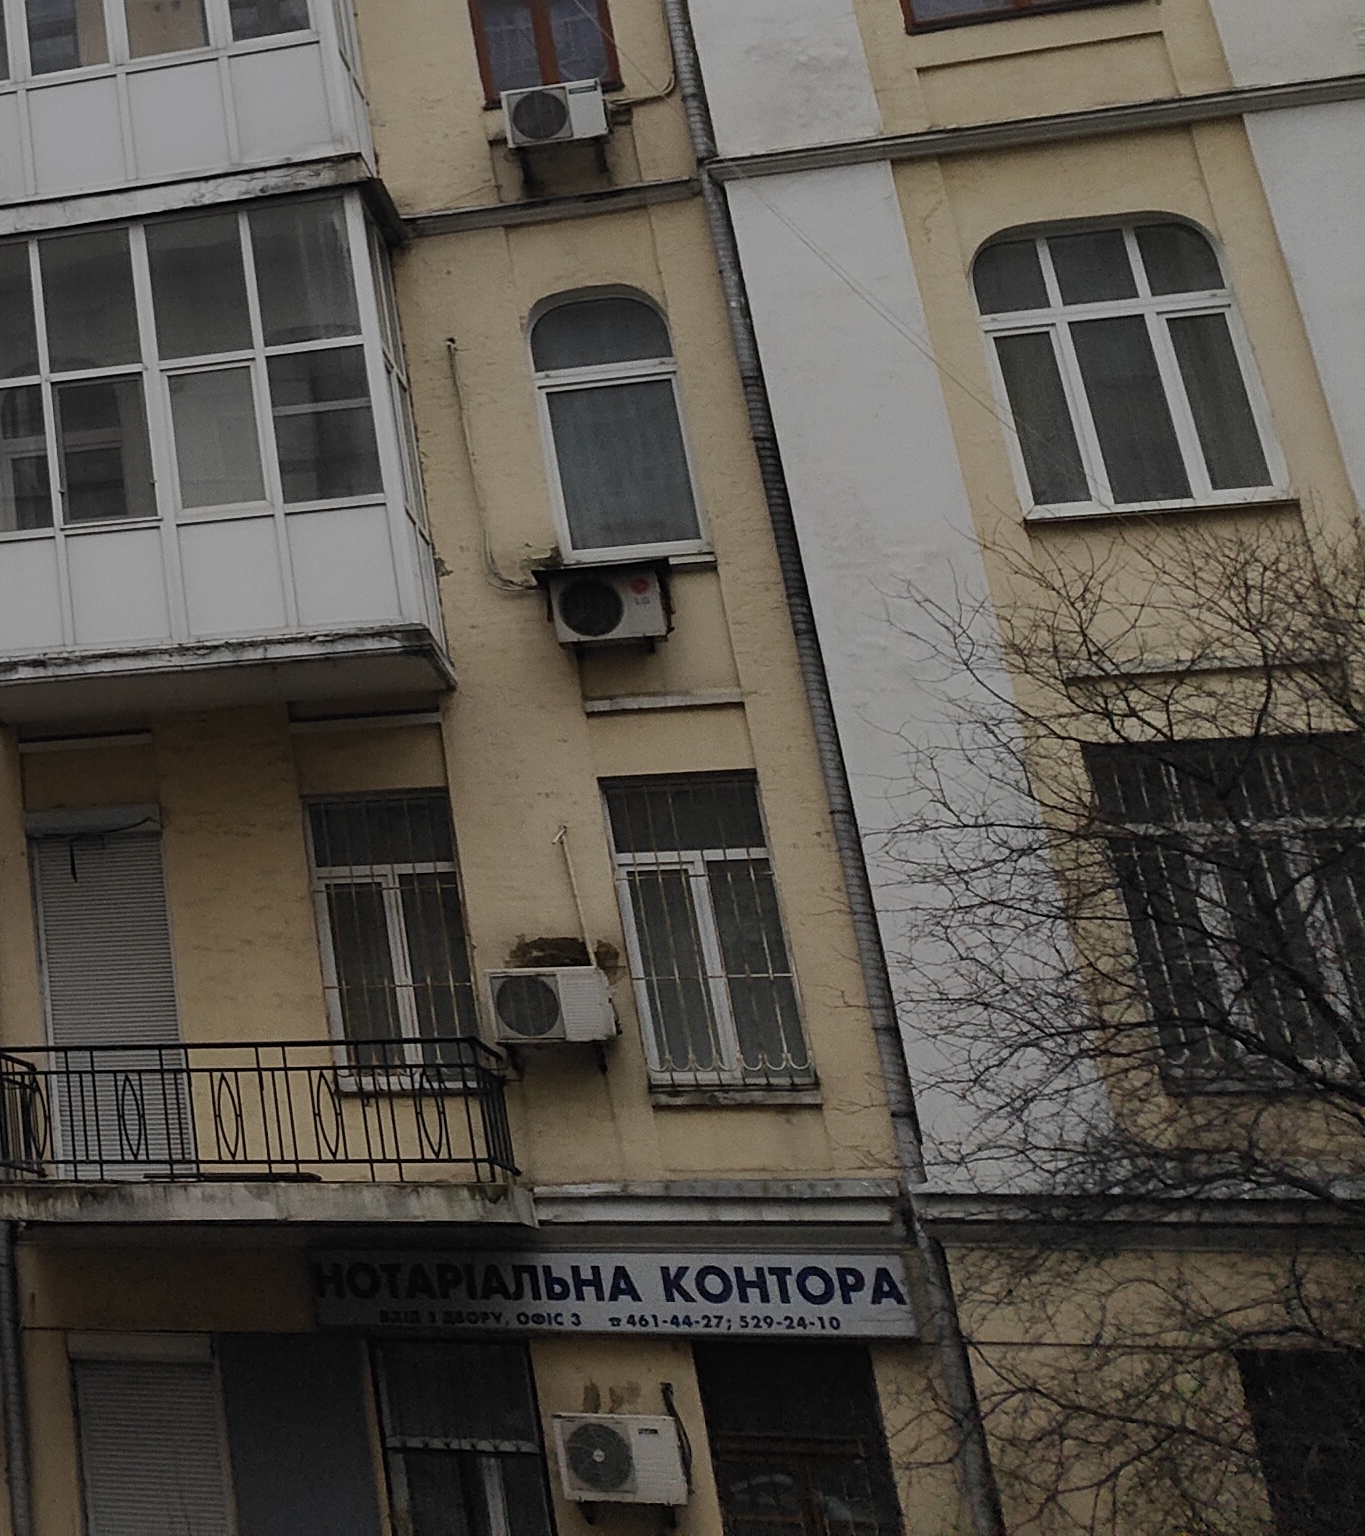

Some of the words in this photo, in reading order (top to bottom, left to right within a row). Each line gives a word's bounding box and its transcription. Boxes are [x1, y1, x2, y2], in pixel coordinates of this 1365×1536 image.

[316, 1263, 642, 1302] НОТАРІАЛЬНА
[660, 1265, 907, 1305] КОНТОРА
[516, 1312, 564, 1326] ОФІС
[626, 1314, 731, 1330] 461-44-27;
[739, 1315, 841, 1331] 529-24-10
